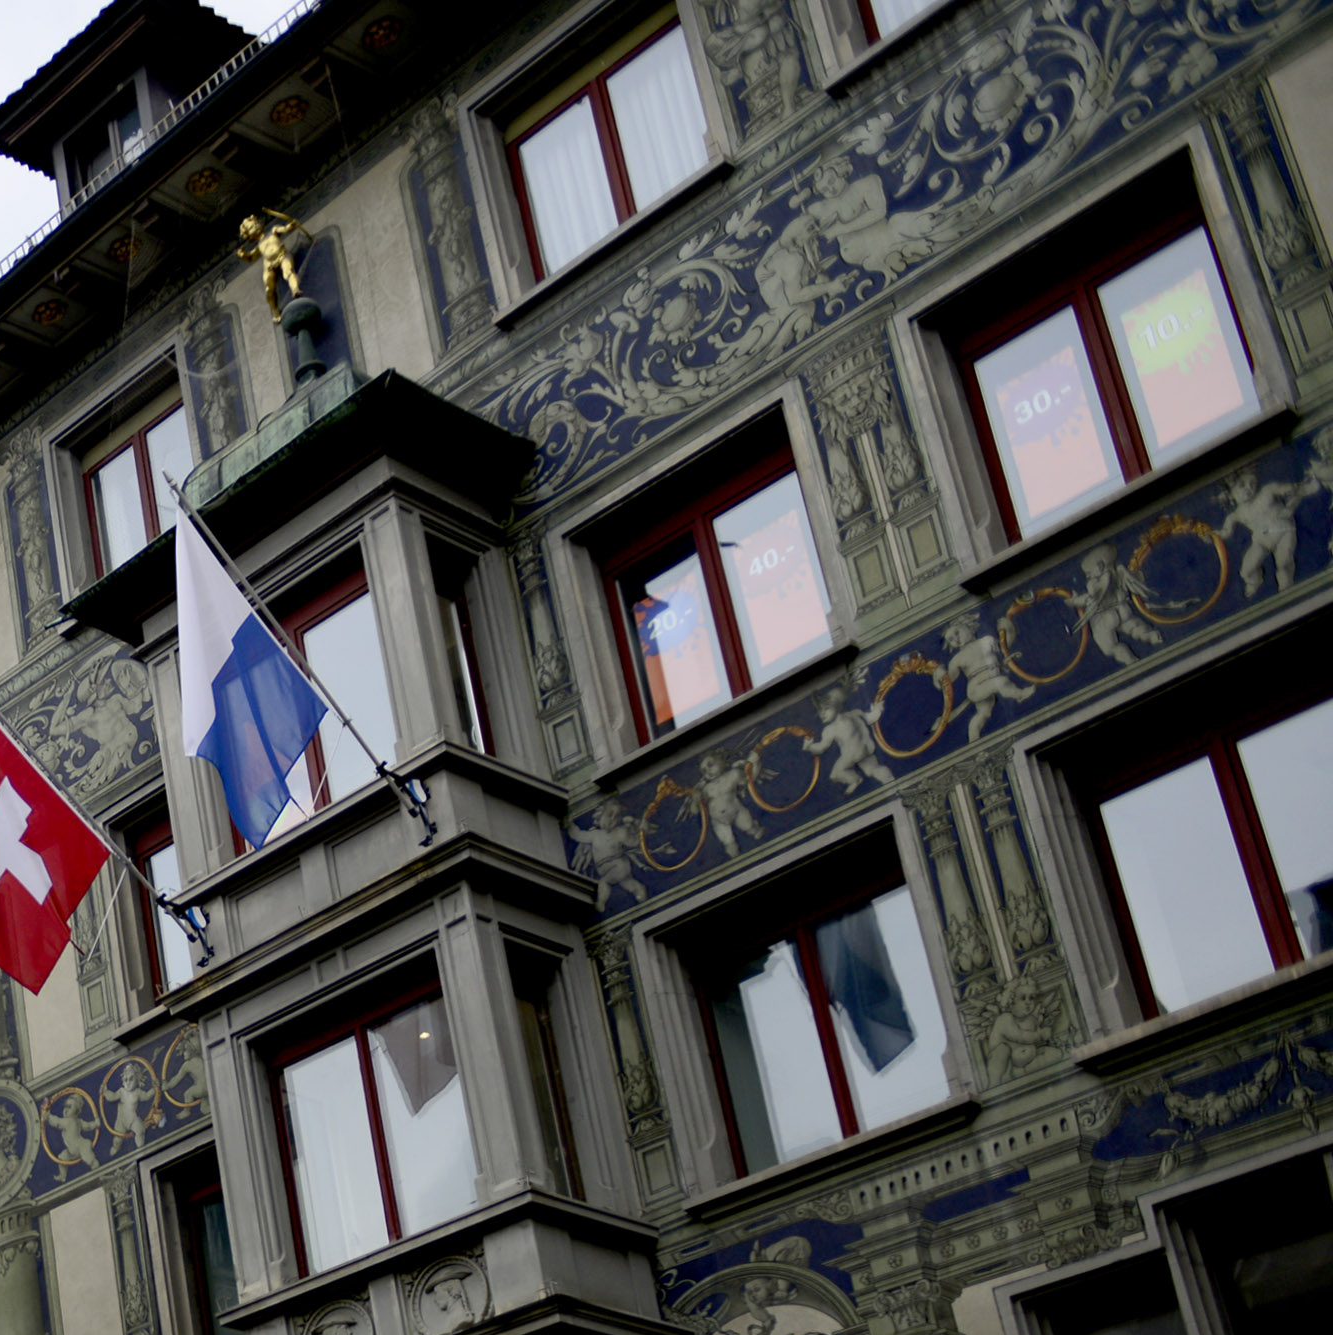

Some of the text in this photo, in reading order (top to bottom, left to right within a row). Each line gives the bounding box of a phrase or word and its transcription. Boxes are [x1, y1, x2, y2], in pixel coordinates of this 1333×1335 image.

[1014, 385, 1071, 424] 30.-
[749, 545, 794, 576] 40.-
[647, 607, 693, 640] 20.-
